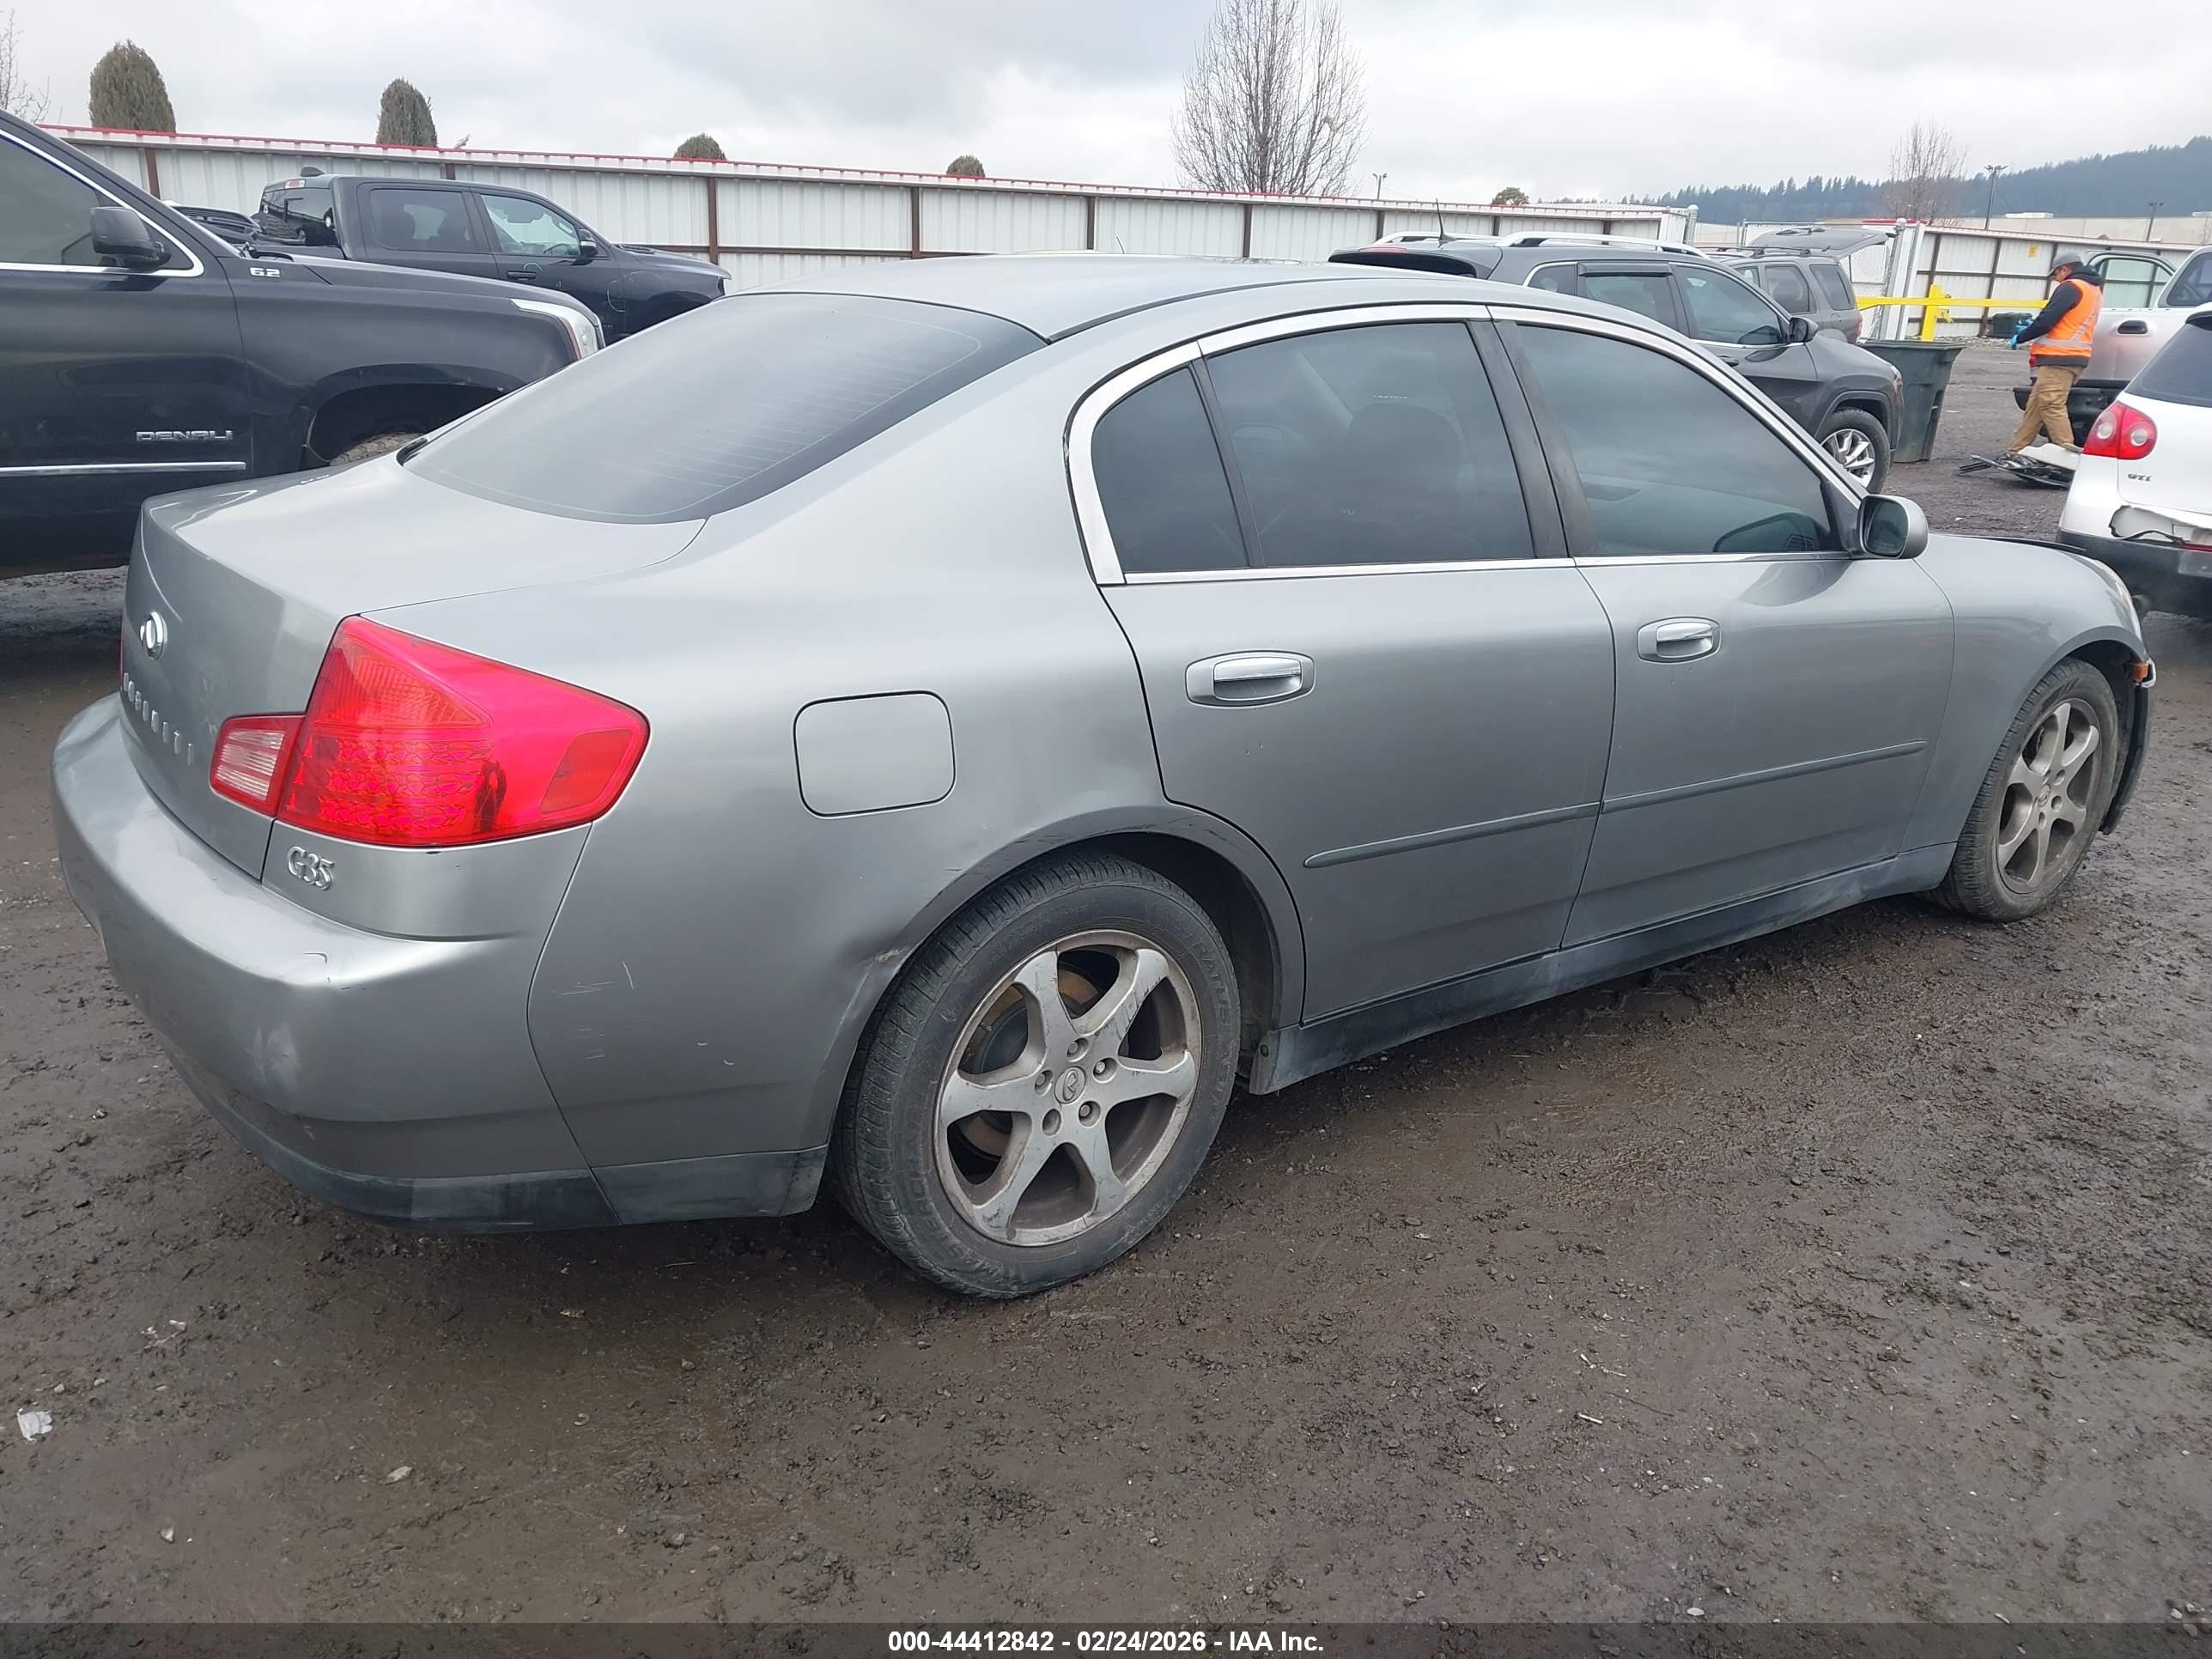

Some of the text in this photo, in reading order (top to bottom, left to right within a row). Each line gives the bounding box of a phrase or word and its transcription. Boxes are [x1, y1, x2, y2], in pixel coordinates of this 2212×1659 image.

[250, 267, 281, 277] 6.2
[136, 430, 233, 441] DENALI
[2128, 473, 2151, 482] GTI
[288, 846, 334, 890] G35
